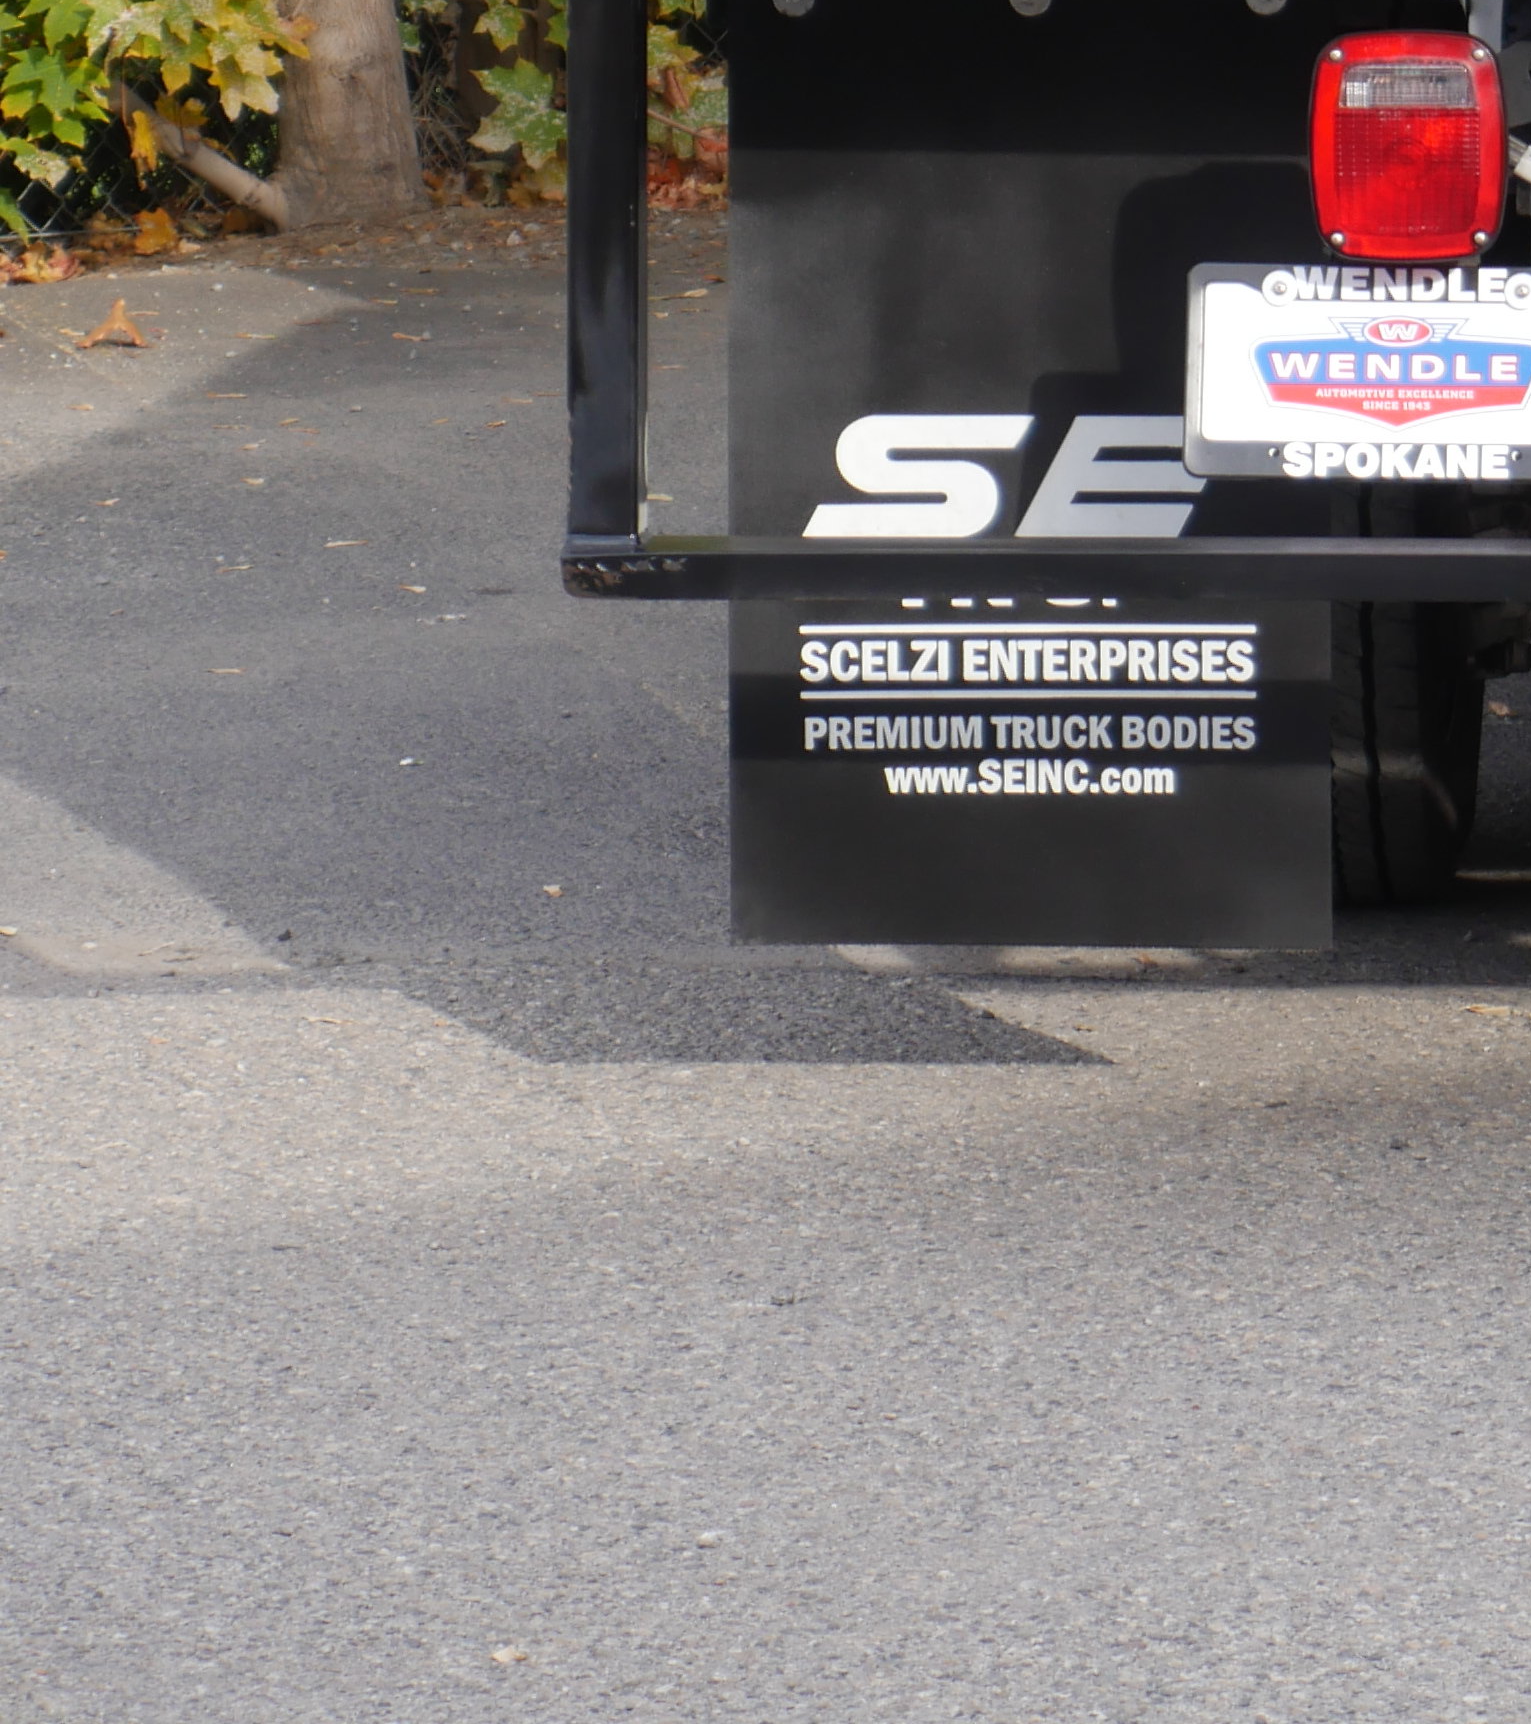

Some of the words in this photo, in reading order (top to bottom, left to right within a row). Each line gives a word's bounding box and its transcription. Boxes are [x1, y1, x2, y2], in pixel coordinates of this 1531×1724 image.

[1292, 265, 1509, 303] WENDLE
[1270, 352, 1519, 382] WENDLE
[1315, 387, 1394, 399] AUTOMOTIVE
[1398, 388, 1475, 400] EXCELLENCE
[1362, 400, 1399, 411] SINCE
[1402, 401, 1431, 411] 1943
[802, 414, 1207, 538] SE
[1282, 441, 1510, 479] SPOKANE
[800, 639, 949, 682] SCELZI
[962, 639, 1255, 682] ENTERPRISES
[803, 715, 983, 751] PREMIUM
[990, 715, 1114, 751] TRUCK
[1121, 715, 1257, 751] BODIES
[883, 758, 1176, 795] www.SEINC.com
